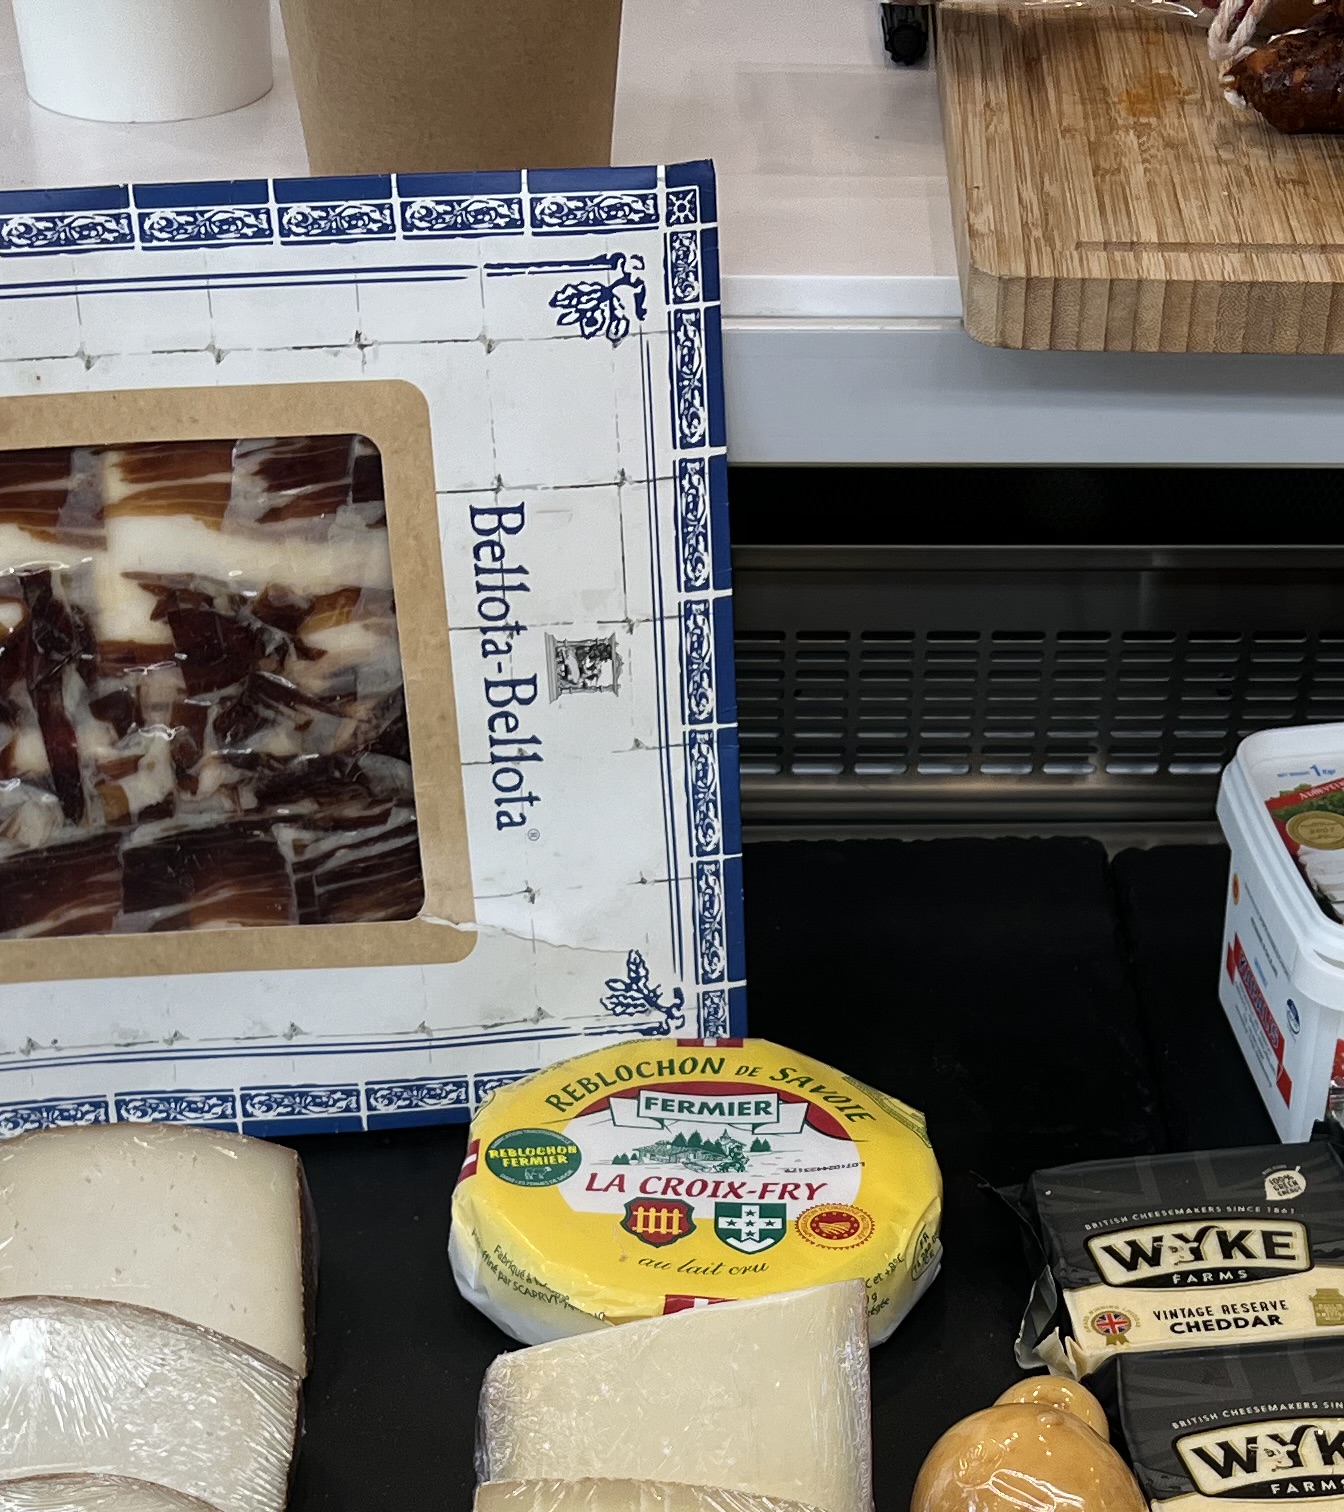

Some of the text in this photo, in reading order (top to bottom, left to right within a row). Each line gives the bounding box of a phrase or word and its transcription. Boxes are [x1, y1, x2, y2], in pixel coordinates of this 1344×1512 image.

[469, 501, 544, 831] Bellota-Bellota
[545, 1056, 877, 1124] REBLOCHON DE SAVOIE
[643, 1096, 773, 1117] FERMIER
[488, 1145, 578, 1159] REBLOCHON
[502, 1154, 569, 1168] FERMIER
[585, 1172, 627, 1194] LA
[638, 1174, 829, 1201] CROIX-FRY
[1084, 1205, 1295, 1231] BRITISH CHEESEMAKERS SINCE 1861
[1100, 1225, 1298, 1273] WYKE
[493, 1244, 526, 1281] Fabriqué
[639, 1254, 770, 1276] au lait cru
[497, 1270, 512, 1288] par
[1172, 1269, 1249, 1285] FARMS
[1152, 1299, 1290, 1322] VINTAGE RESERVE
[1169, 1314, 1284, 1336] CHEDDAR
[1171, 1412, 1219, 1431] BRITISH
[1222, 1401, 1319, 1419] CHEESEMAKERS
